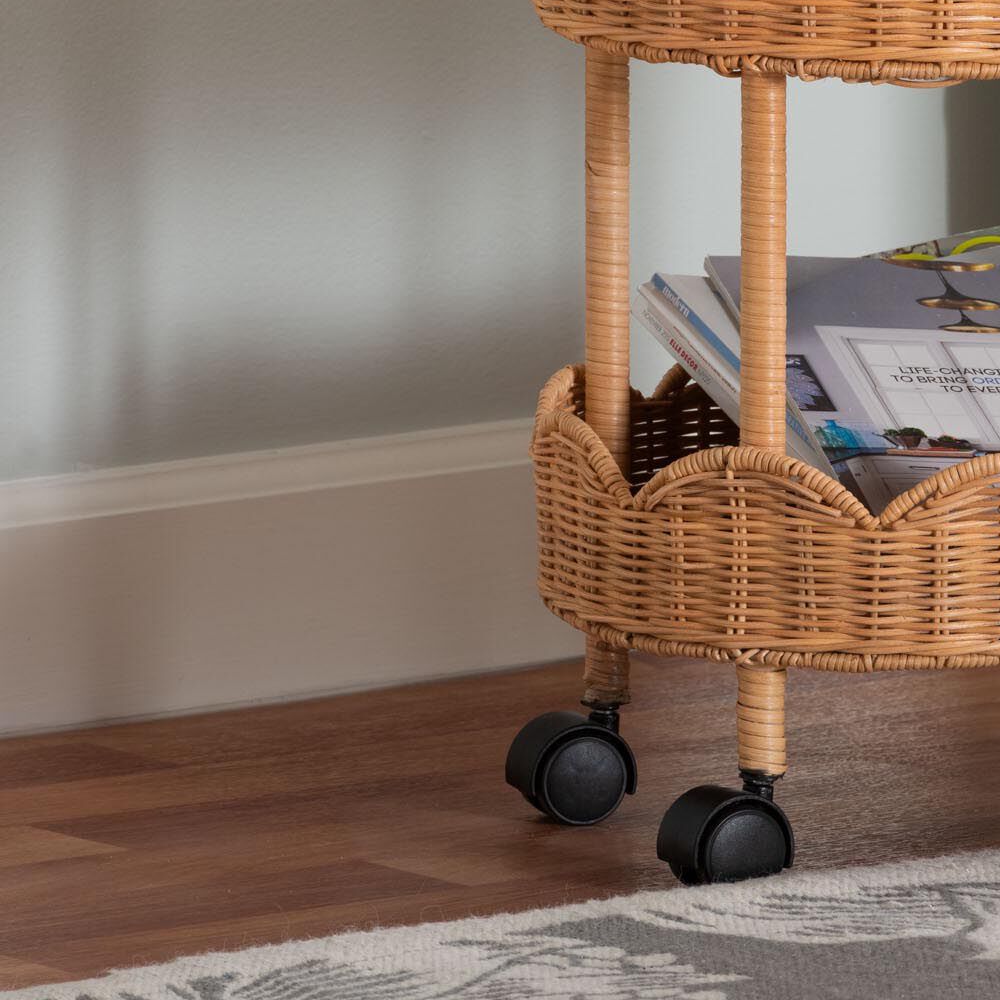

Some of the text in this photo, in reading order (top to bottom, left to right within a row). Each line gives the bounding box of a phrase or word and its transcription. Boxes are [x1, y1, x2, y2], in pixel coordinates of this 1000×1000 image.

[668, 338, 699, 371] ELLE DECOR
[890, 375, 913, 383] TO
[916, 375, 968, 384] BRING
[940, 385, 963, 393] TO
